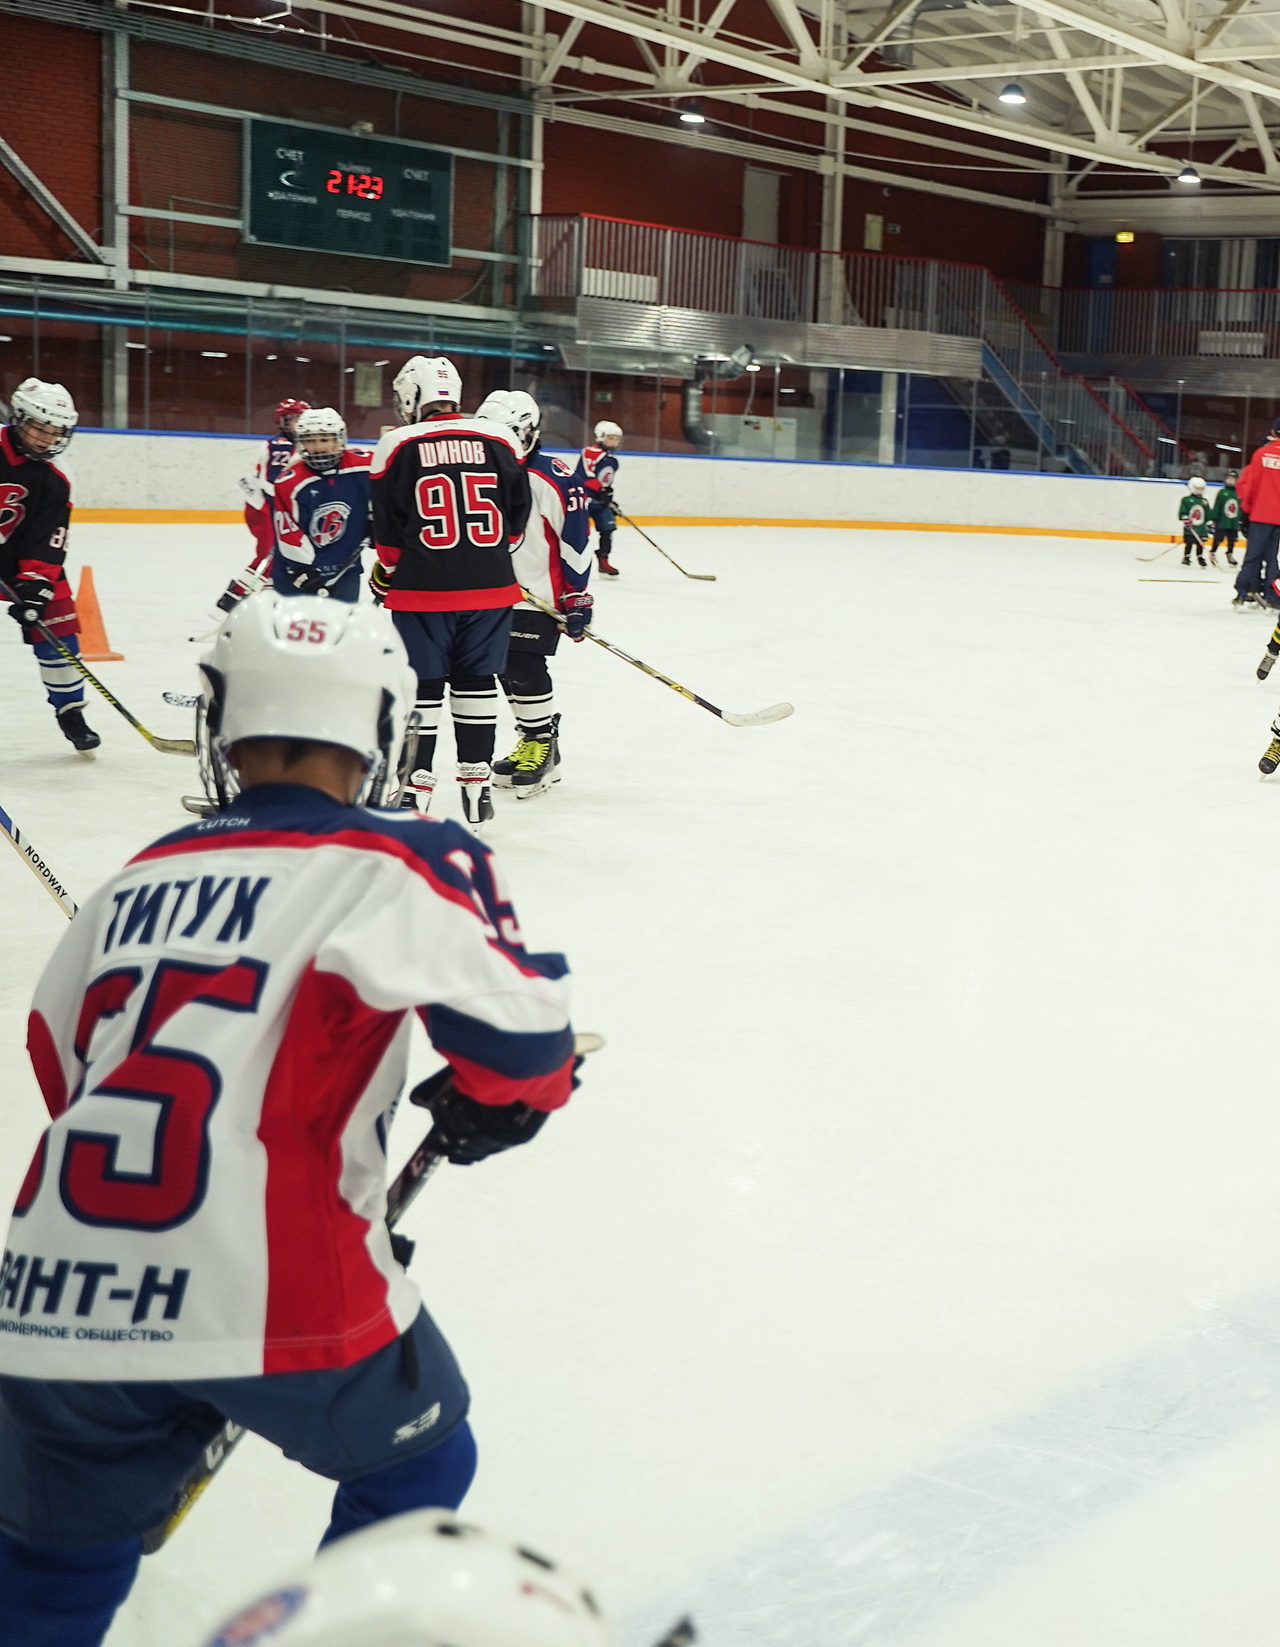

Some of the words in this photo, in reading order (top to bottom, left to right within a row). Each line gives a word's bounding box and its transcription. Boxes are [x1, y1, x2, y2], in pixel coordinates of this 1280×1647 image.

[418, 439, 486, 468] ШИНОВ
[415, 471, 504, 550] 95
[286, 619, 328, 644] 55
[197, 817, 251, 831] LUTCH
[25, 845, 68, 898] NORDWAY
[0, 1248, 191, 1325] ВАНТ-Н
[75, 1327, 175, 1343] ОБЩЕСТВО
